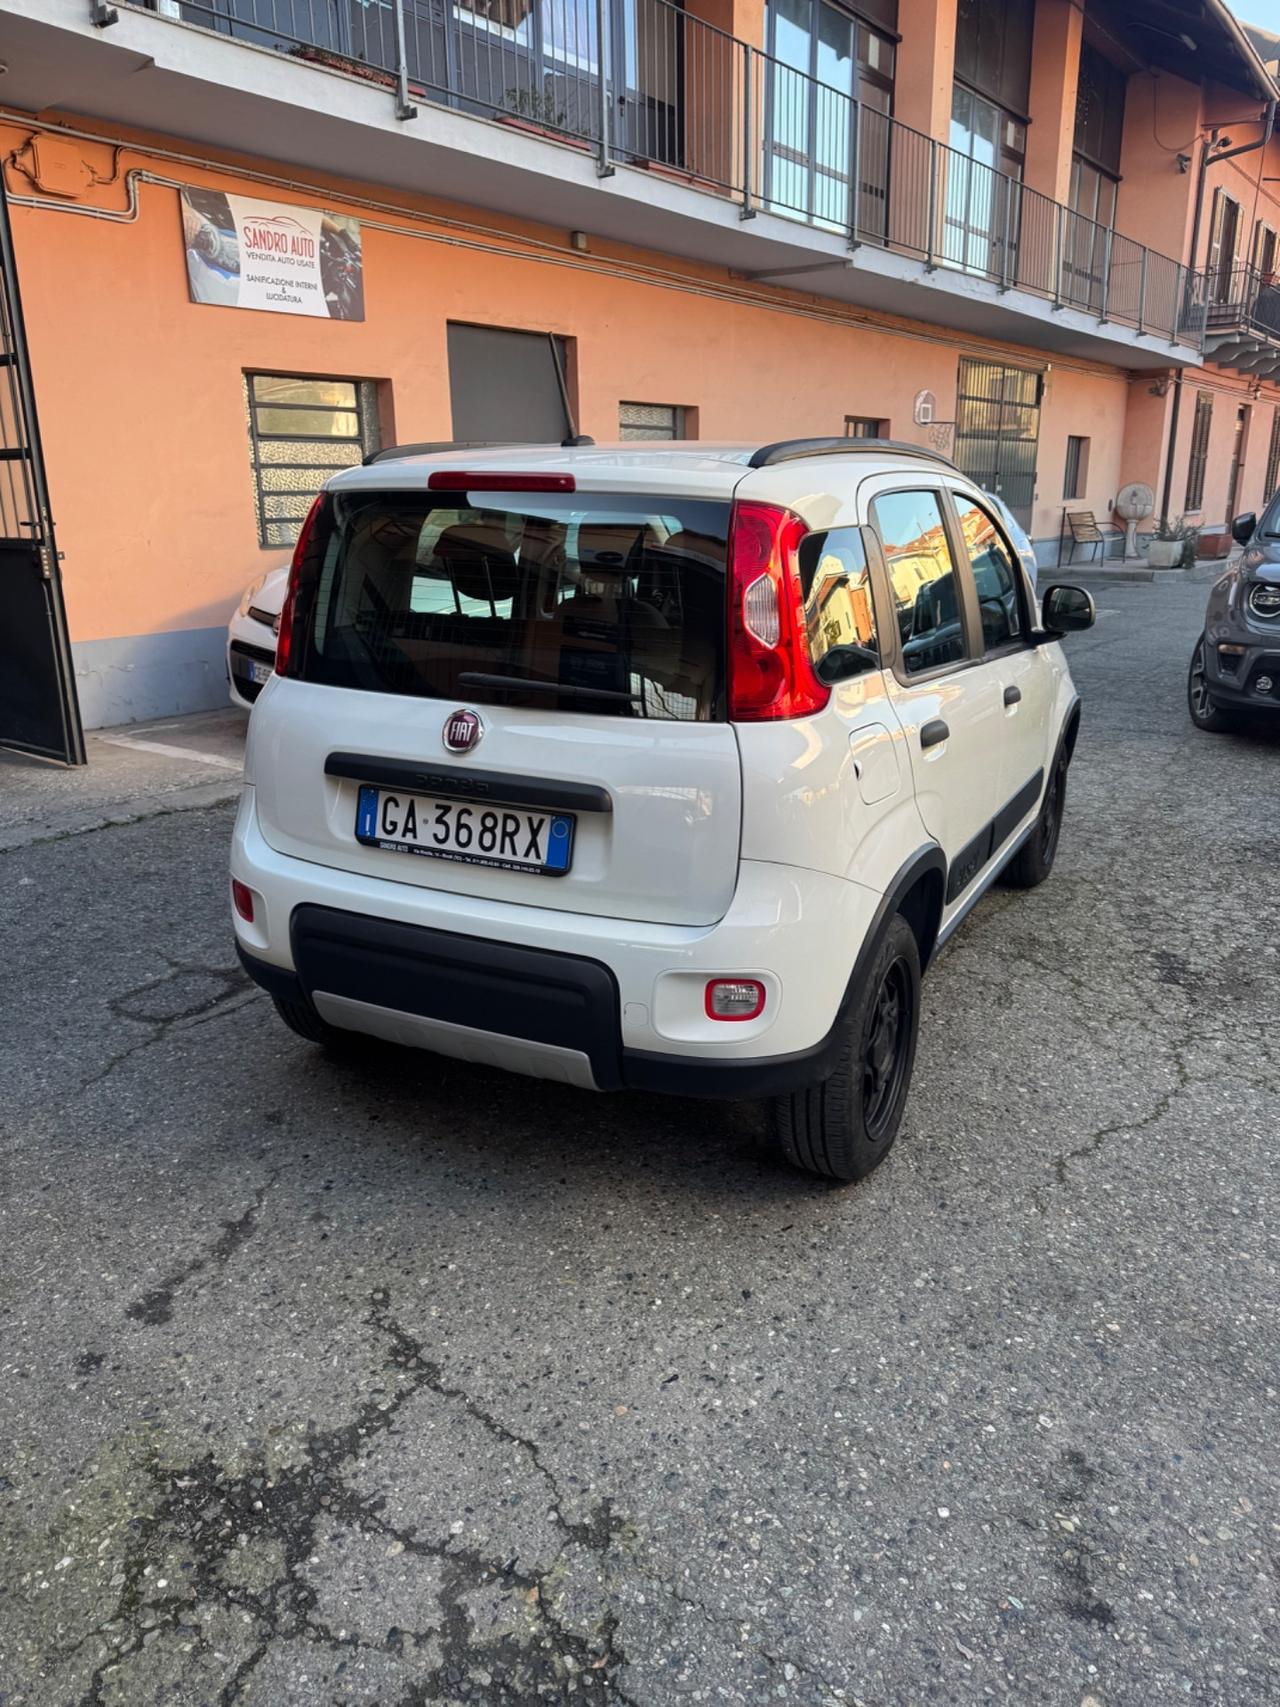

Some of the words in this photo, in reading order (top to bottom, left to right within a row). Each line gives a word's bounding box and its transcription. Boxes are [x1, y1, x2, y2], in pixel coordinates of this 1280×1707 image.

[243, 226, 288, 253] SANDRO
[291, 236, 314, 258] AUTO
[246, 251, 276, 261] VENDITA
[277, 256, 295, 265] AUTO
[297, 260, 315, 269] USATE
[246, 274, 294, 287] SANIFICAZIONE
[295, 281, 317, 290] INTERNI
[266, 293, 303, 303] LUCIDATURA
[450, 721, 475, 742] FIAT
[381, 796, 418, 840] GA
